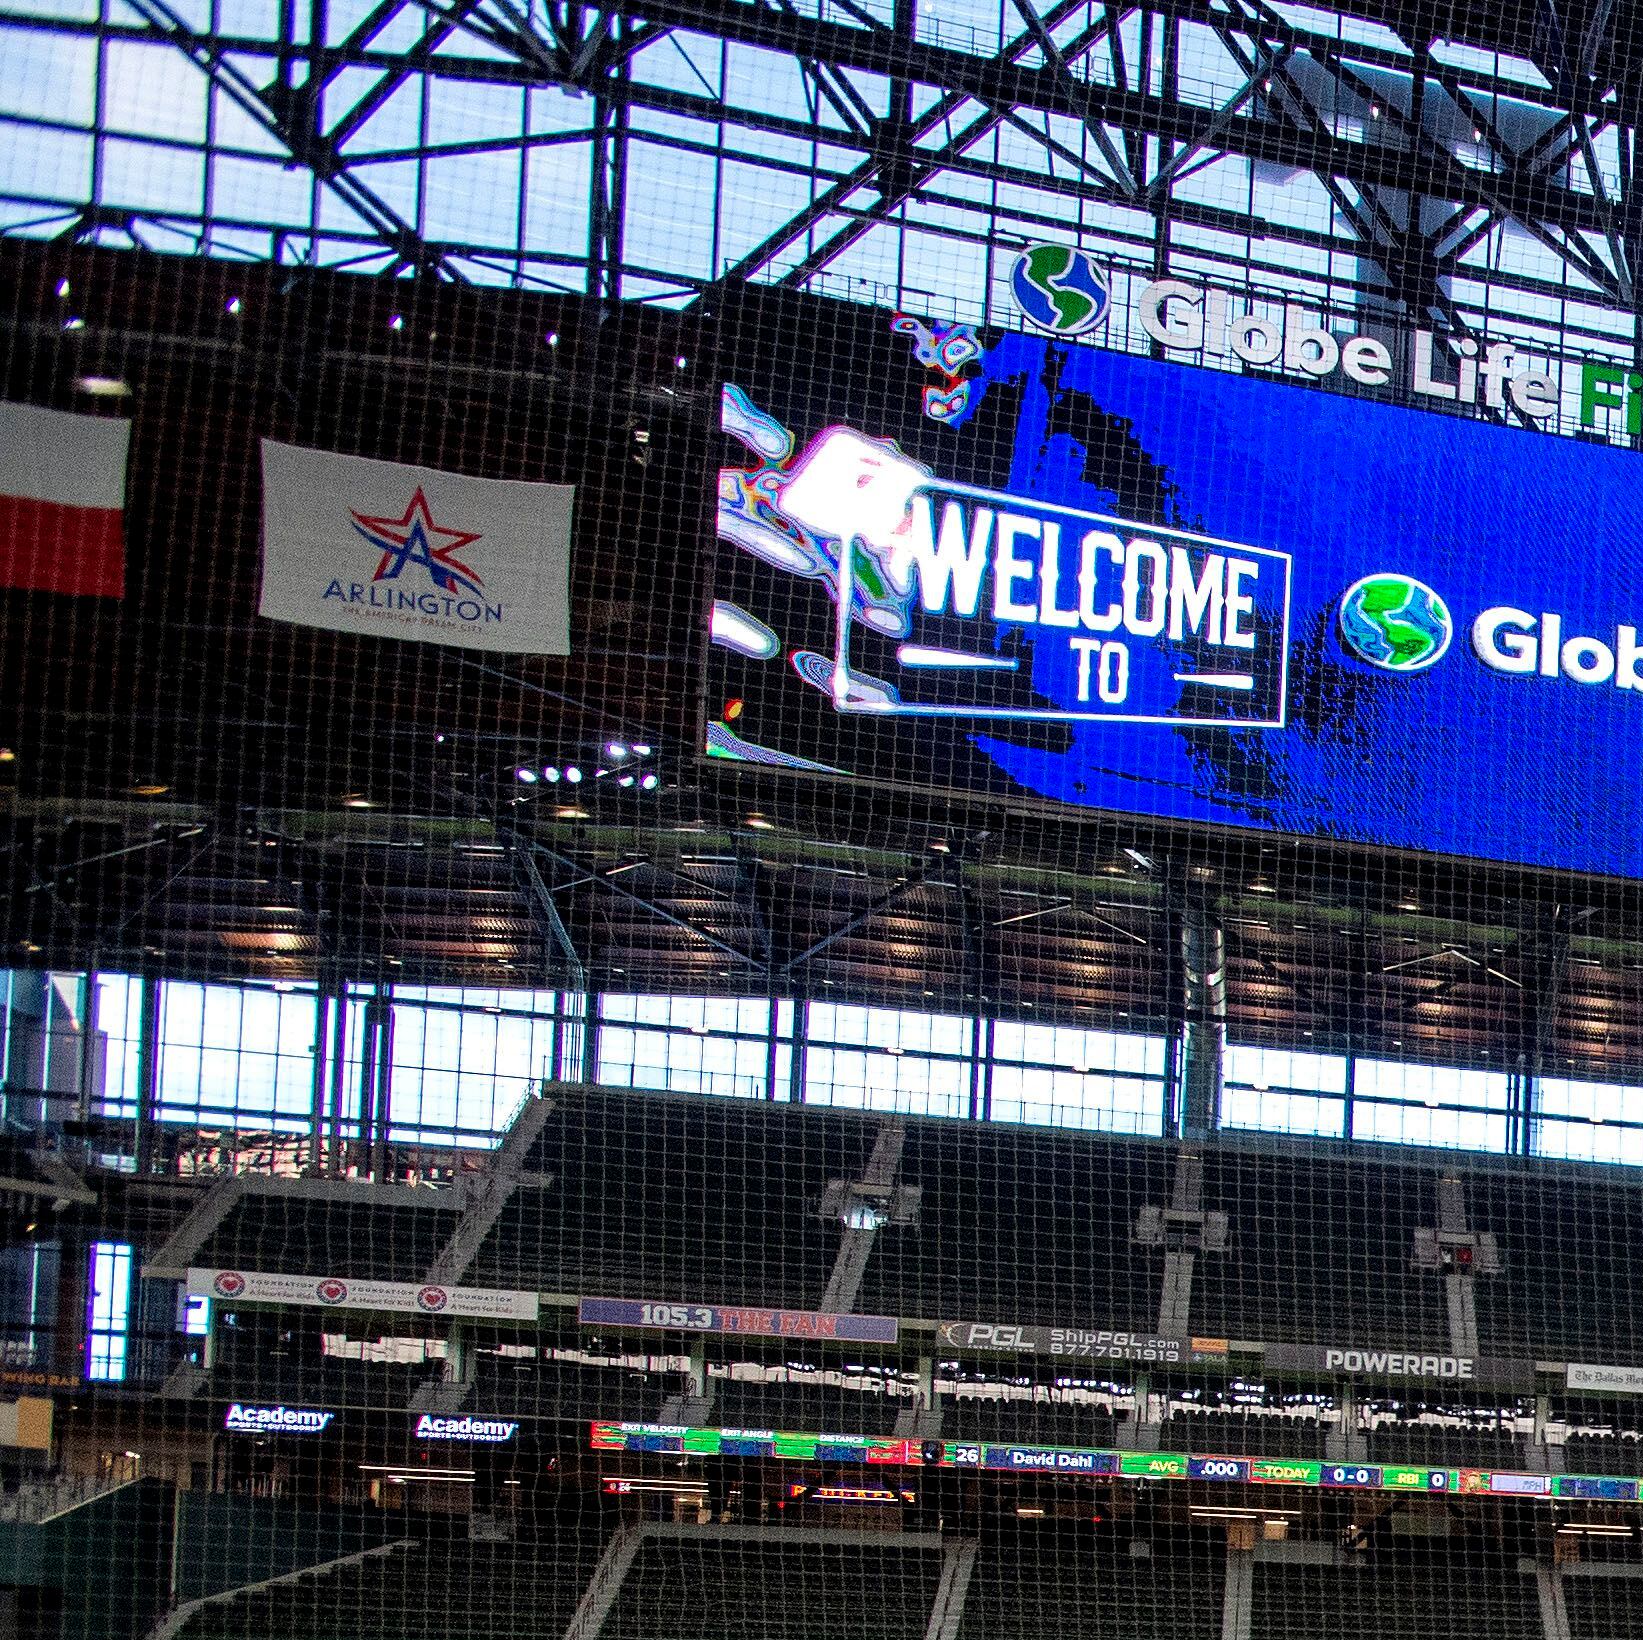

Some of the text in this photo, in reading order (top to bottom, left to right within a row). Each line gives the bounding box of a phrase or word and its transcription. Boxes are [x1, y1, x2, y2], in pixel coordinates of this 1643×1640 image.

[1138, 280, 1392, 386] Globe
[1413, 330, 1559, 418] Life
[911, 496, 1259, 649] WELCOME
[322, 578, 503, 622] ARLINGTON
[1069, 637, 1129, 703] TO
[640, 1304, 838, 1337] 105.3 THE FAN
[967, 1324, 1036, 1348] PGL
[1051, 1329, 1180, 1350] ShipPGL.com
[1051, 1343, 1179, 1362] 877.701.1919
[1326, 1350, 1474, 1379] POWERADE
[1575, 1370, 1592, 1382] The
[1594, 1371, 1623, 1385] Dallas
[228, 1404, 332, 1431] Academy
[417, 1415, 516, 1440] Academy
[621, 1423, 689, 1435] EXIT VELOCITY
[721, 1429, 774, 1440] EXIT ANGLE
[820, 1435, 864, 1444] DISTANCE
[957, 1449, 978, 1463] 26
[1013, 1451, 1093, 1468] David Dahl
[1149, 1459, 1238, 1476] AVG .000
[1265, 1466, 1311, 1480] TODAY
[1398, 1474, 1444, 1487] RBI 0
